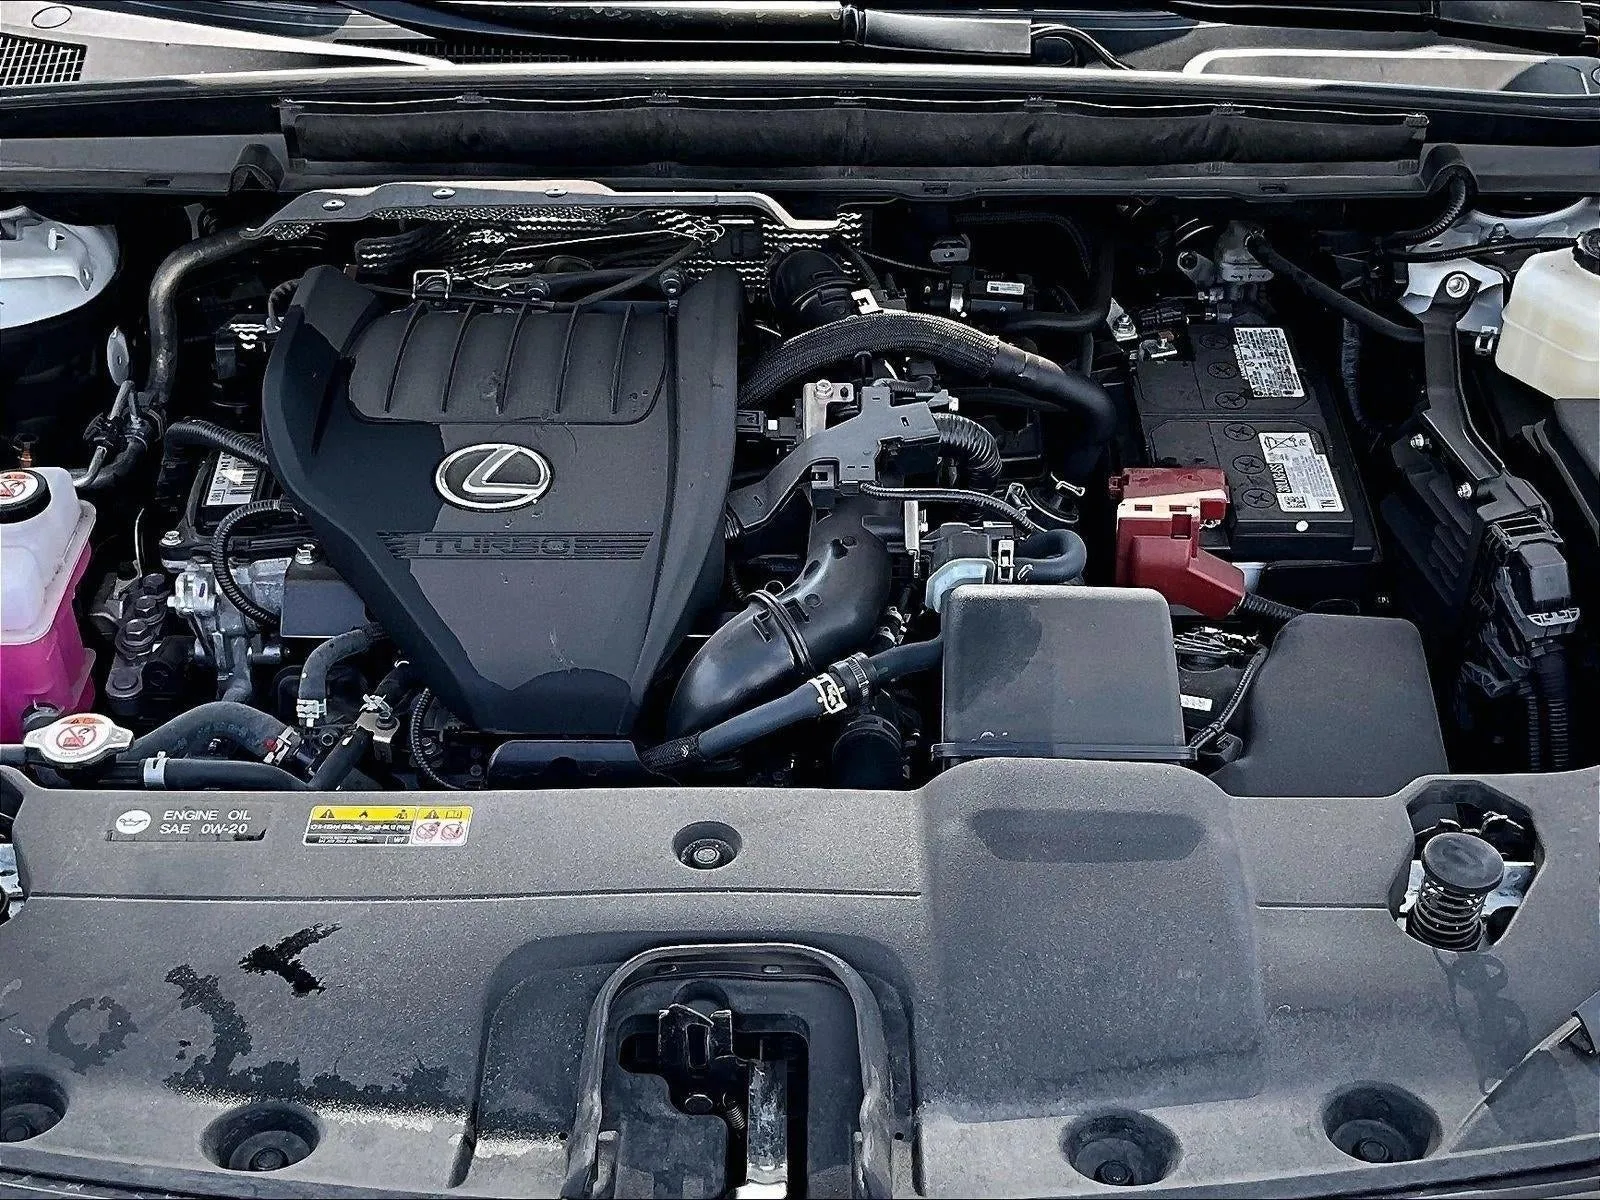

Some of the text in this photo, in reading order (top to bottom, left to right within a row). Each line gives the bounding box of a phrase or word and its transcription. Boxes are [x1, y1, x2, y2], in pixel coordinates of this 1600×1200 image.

[424, 536, 571, 554] TURBO
[163, 809, 252, 821] ENGINE OIL
[159, 823, 248, 834] SAE 0W-20
